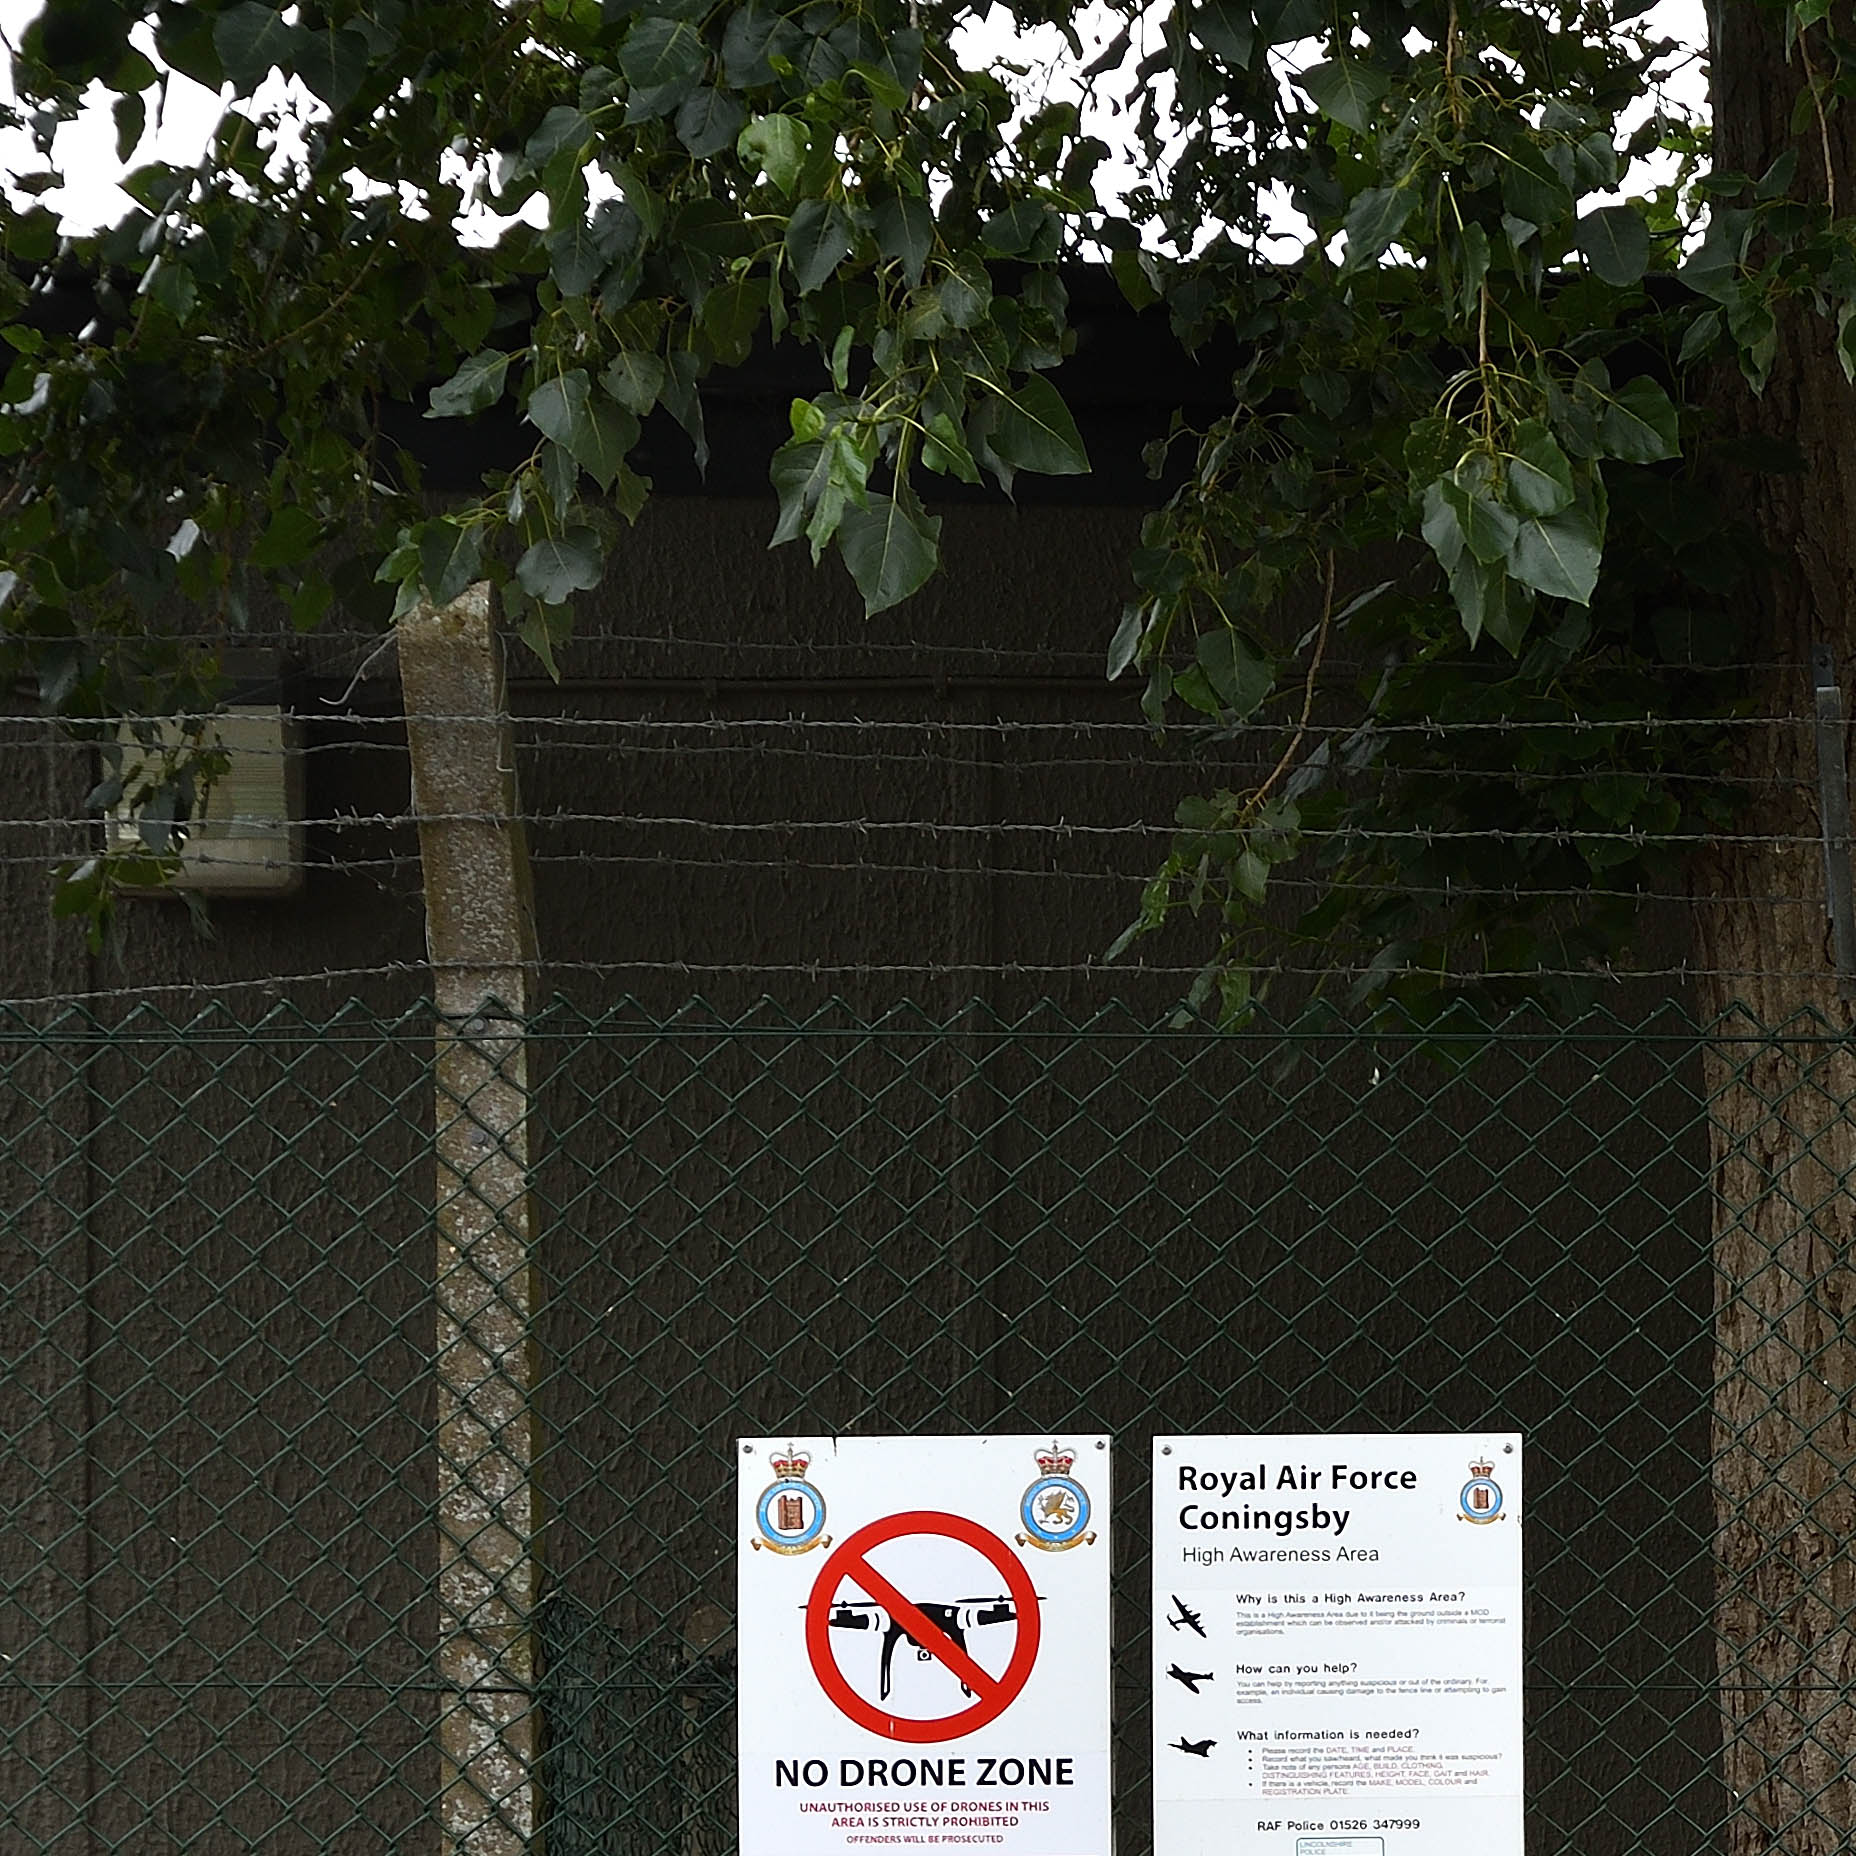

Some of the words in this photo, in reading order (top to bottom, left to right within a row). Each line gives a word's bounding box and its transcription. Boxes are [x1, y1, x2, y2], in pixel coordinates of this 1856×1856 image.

[1179, 1463, 1266, 1495] Royal
[1276, 1464, 1322, 1490] Air
[1332, 1464, 1417, 1490] Force
[1179, 1502, 1350, 1537] Coningsby
[1183, 1547, 1224, 1567] High
[1229, 1546, 1331, 1562] Awareness
[1336, 1546, 1379, 1562] Area
[1236, 1594, 1262, 1606] Why
[1267, 1596, 1278, 1604] is
[1284, 1594, 1306, 1604] this
[1311, 1595, 1319, 1604] a
[1324, 1593, 1352, 1606] High
[1357, 1593, 1424, 1603] Awareness
[1429, 1591, 1466, 1602] Area?
[1236, 1664, 1263, 1674] How
[1268, 1665, 1291, 1674] can
[1296, 1665, 1318, 1676] you
[1323, 1662, 1358, 1675] help?
[1237, 1730, 1269, 1741] What
[1274, 1730, 1345, 1740] information
[1349, 1730, 1360, 1740] is
[1365, 1728, 1420, 1739] needed?
[775, 1759, 829, 1787] NO
[840, 1758, 966, 1787] DRONE
[975, 1758, 1074, 1786] ZONE
[799, 1802, 901, 1813] UNAUTHORISED
[903, 1801, 928, 1813] USE
[930, 1801, 947, 1813] OF
[950, 1801, 1003, 1812] DRONES
[1005, 1801, 1019, 1812] IN
[1021, 1801, 1050, 1812] THIS
[831, 1817, 865, 1828] AREA
[868, 1816, 879, 1828] IS
[882, 1816, 939, 1828] STRICTLY
[942, 1816, 1019, 1827] PROHIBITED
[1257, 1820, 1282, 1831] RAF
[1287, 1820, 1324, 1831] Police
[1329, 1819, 1368, 1831] 01526
[1373, 1818, 1420, 1830] 347999
[845, 1835, 903, 1844] OFFENDERS
[904, 1835, 926, 1844] WILL
[927, 1835, 939, 1844] BE
[940, 1834, 1005, 1844] PROSECUTED
